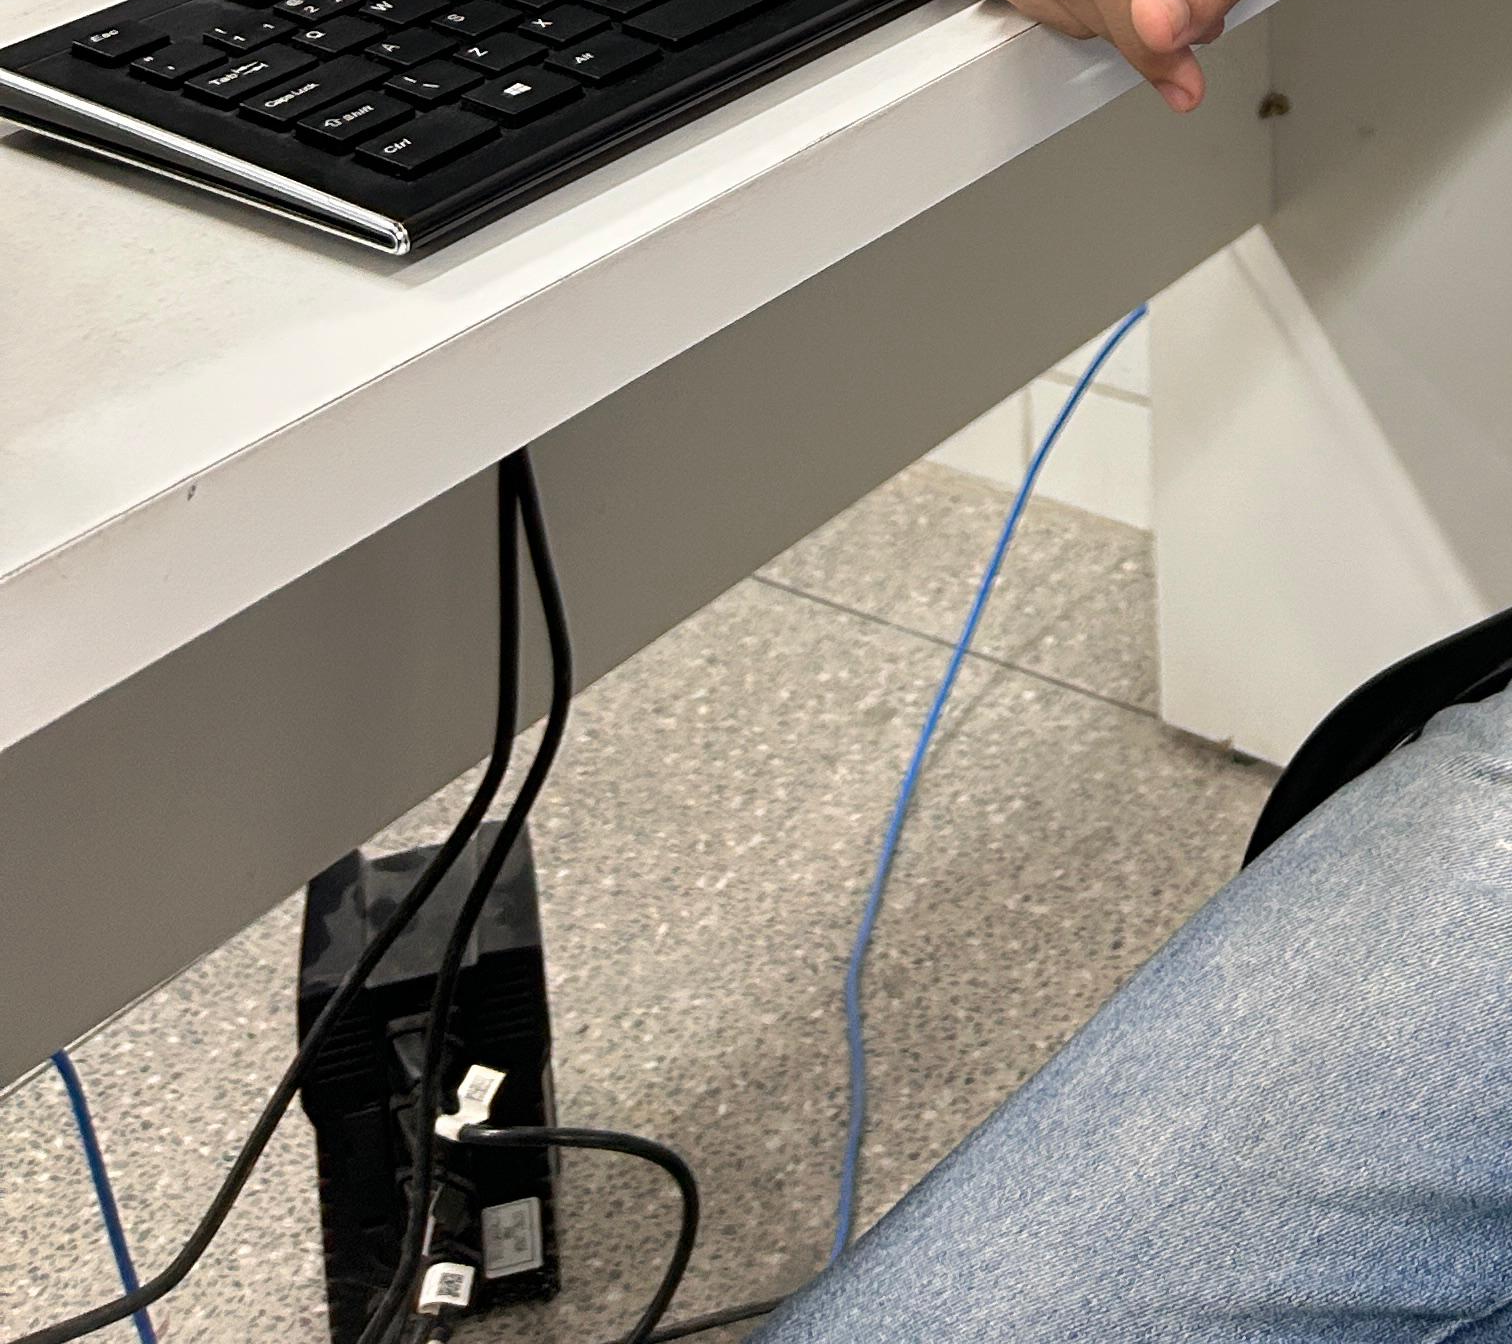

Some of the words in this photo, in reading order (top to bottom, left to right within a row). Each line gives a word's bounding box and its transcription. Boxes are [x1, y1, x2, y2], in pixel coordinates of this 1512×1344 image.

[370, 0, 393, 12] W
[531, 18, 553, 28] X
[90, 28, 119, 43] Esc
[305, 29, 326, 40] Q
[381, 42, 400, 53] A
[467, 46, 488, 58] Z
[208, 70, 239, 86] Tab
[383, 137, 412, 154] Ctrl
